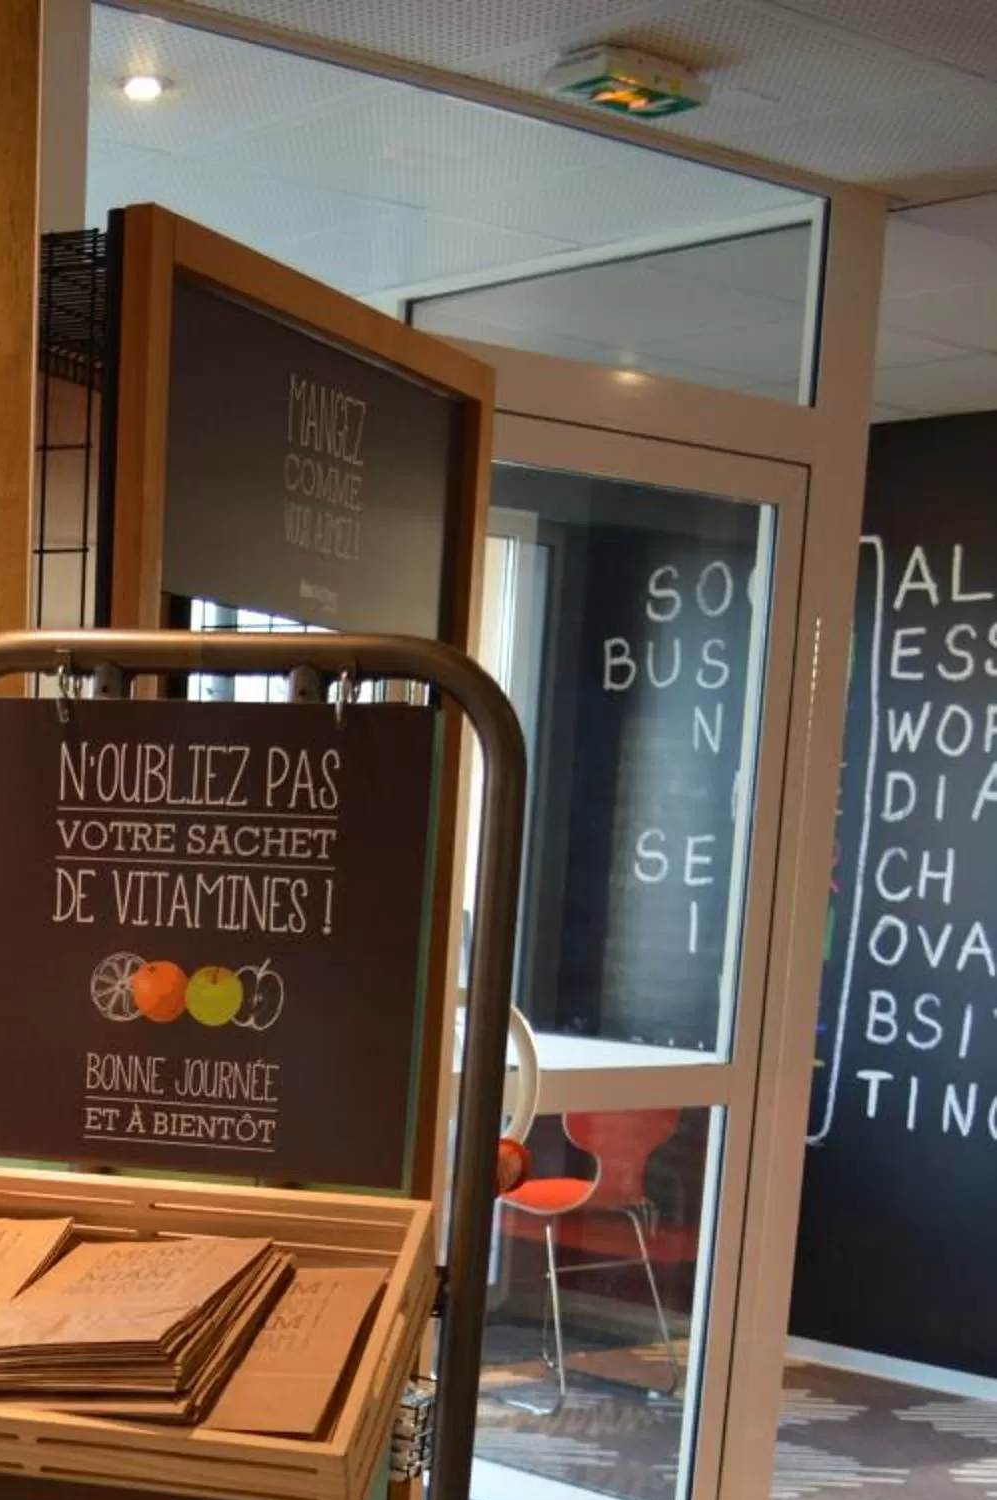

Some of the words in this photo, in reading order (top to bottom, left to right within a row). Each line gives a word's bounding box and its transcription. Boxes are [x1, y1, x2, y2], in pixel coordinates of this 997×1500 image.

[284, 453, 363, 512] COMME
[646, 561, 734, 623] SO
[893, 544, 995, 611] AL
[603, 637, 730, 691] BUS
[693, 703, 724, 754] N
[60, 741, 251, 808] N'OUBLIEZ
[266, 746, 341, 810] PAS
[56, 819, 176, 854] VOTRE
[186, 824, 336, 859] SACHET
[634, 827, 716, 887] SE
[52, 868, 96, 924] DE
[112, 870, 309, 933] VITAMINES
[875, 846, 955, 905] CH
[866, 989, 997, 1059] BSI
[86, 1052, 166, 1095] BONNE
[175, 1057, 280, 1102] JOURNÉE
[84, 1106, 120, 1132] ET
[128, 1103, 149, 1134] À
[153, 1110, 276, 1144] BIENTÔT
